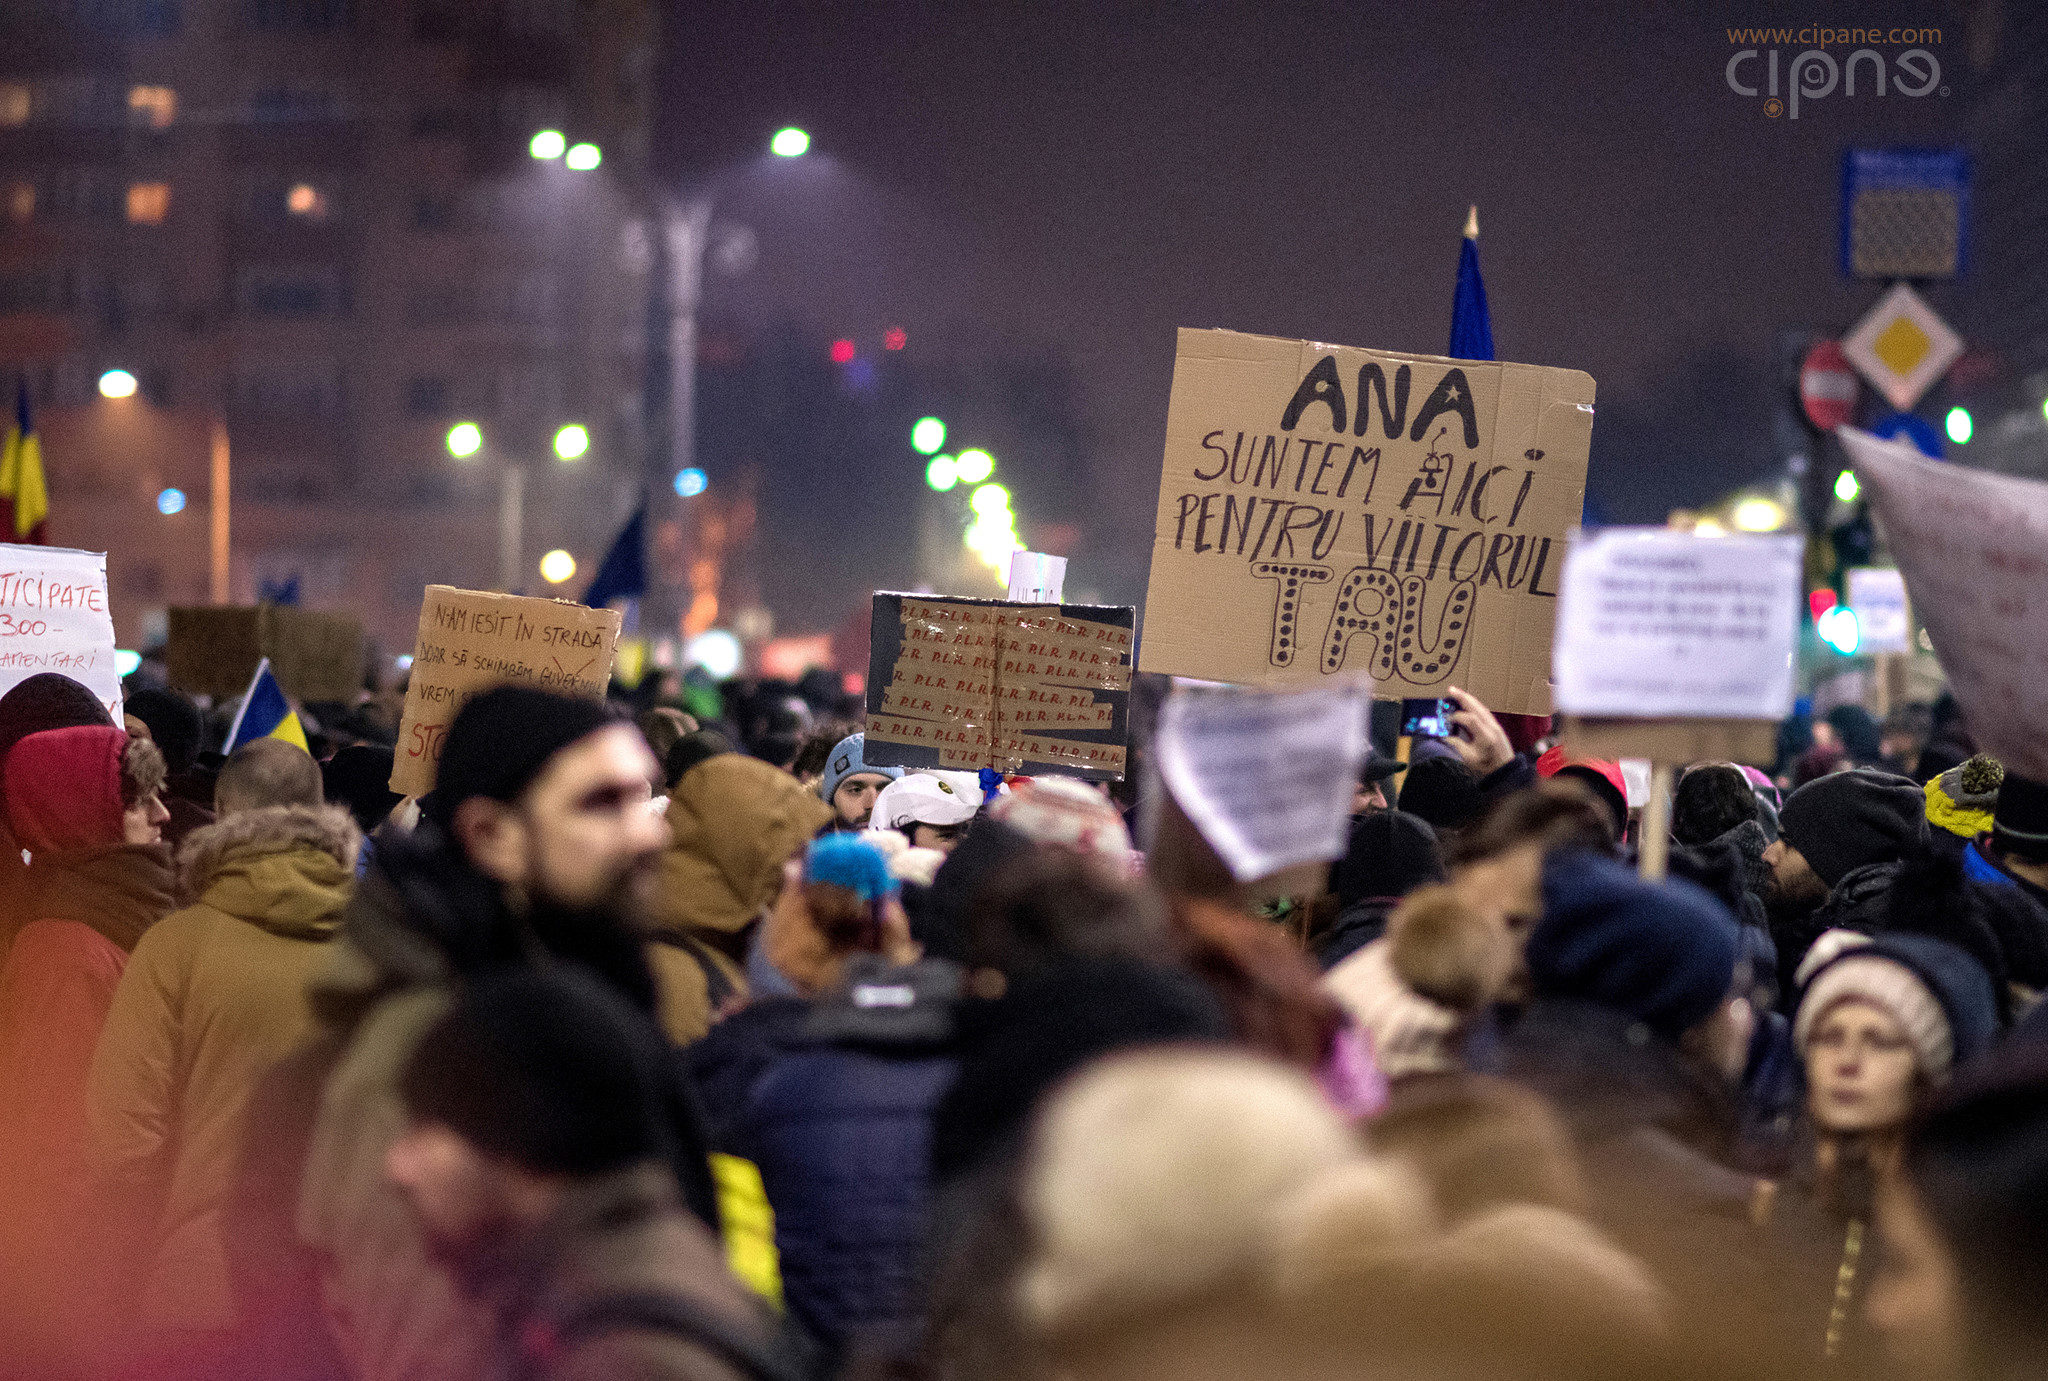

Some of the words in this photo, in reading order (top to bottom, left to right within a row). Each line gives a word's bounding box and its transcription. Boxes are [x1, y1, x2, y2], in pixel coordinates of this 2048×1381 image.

[1280, 355, 1480, 449] ANA
[1193, 430, 1381, 505] SUNTEM
[1400, 446, 1546, 528] AICI
[1173, 493, 1346, 563] PENTRU
[1362, 513, 1557, 598] VIITORUL
[452, 649, 469, 667] SĂ
[543, 625, 607, 650] STRADĂ
[420, 685, 455, 706] VREM
